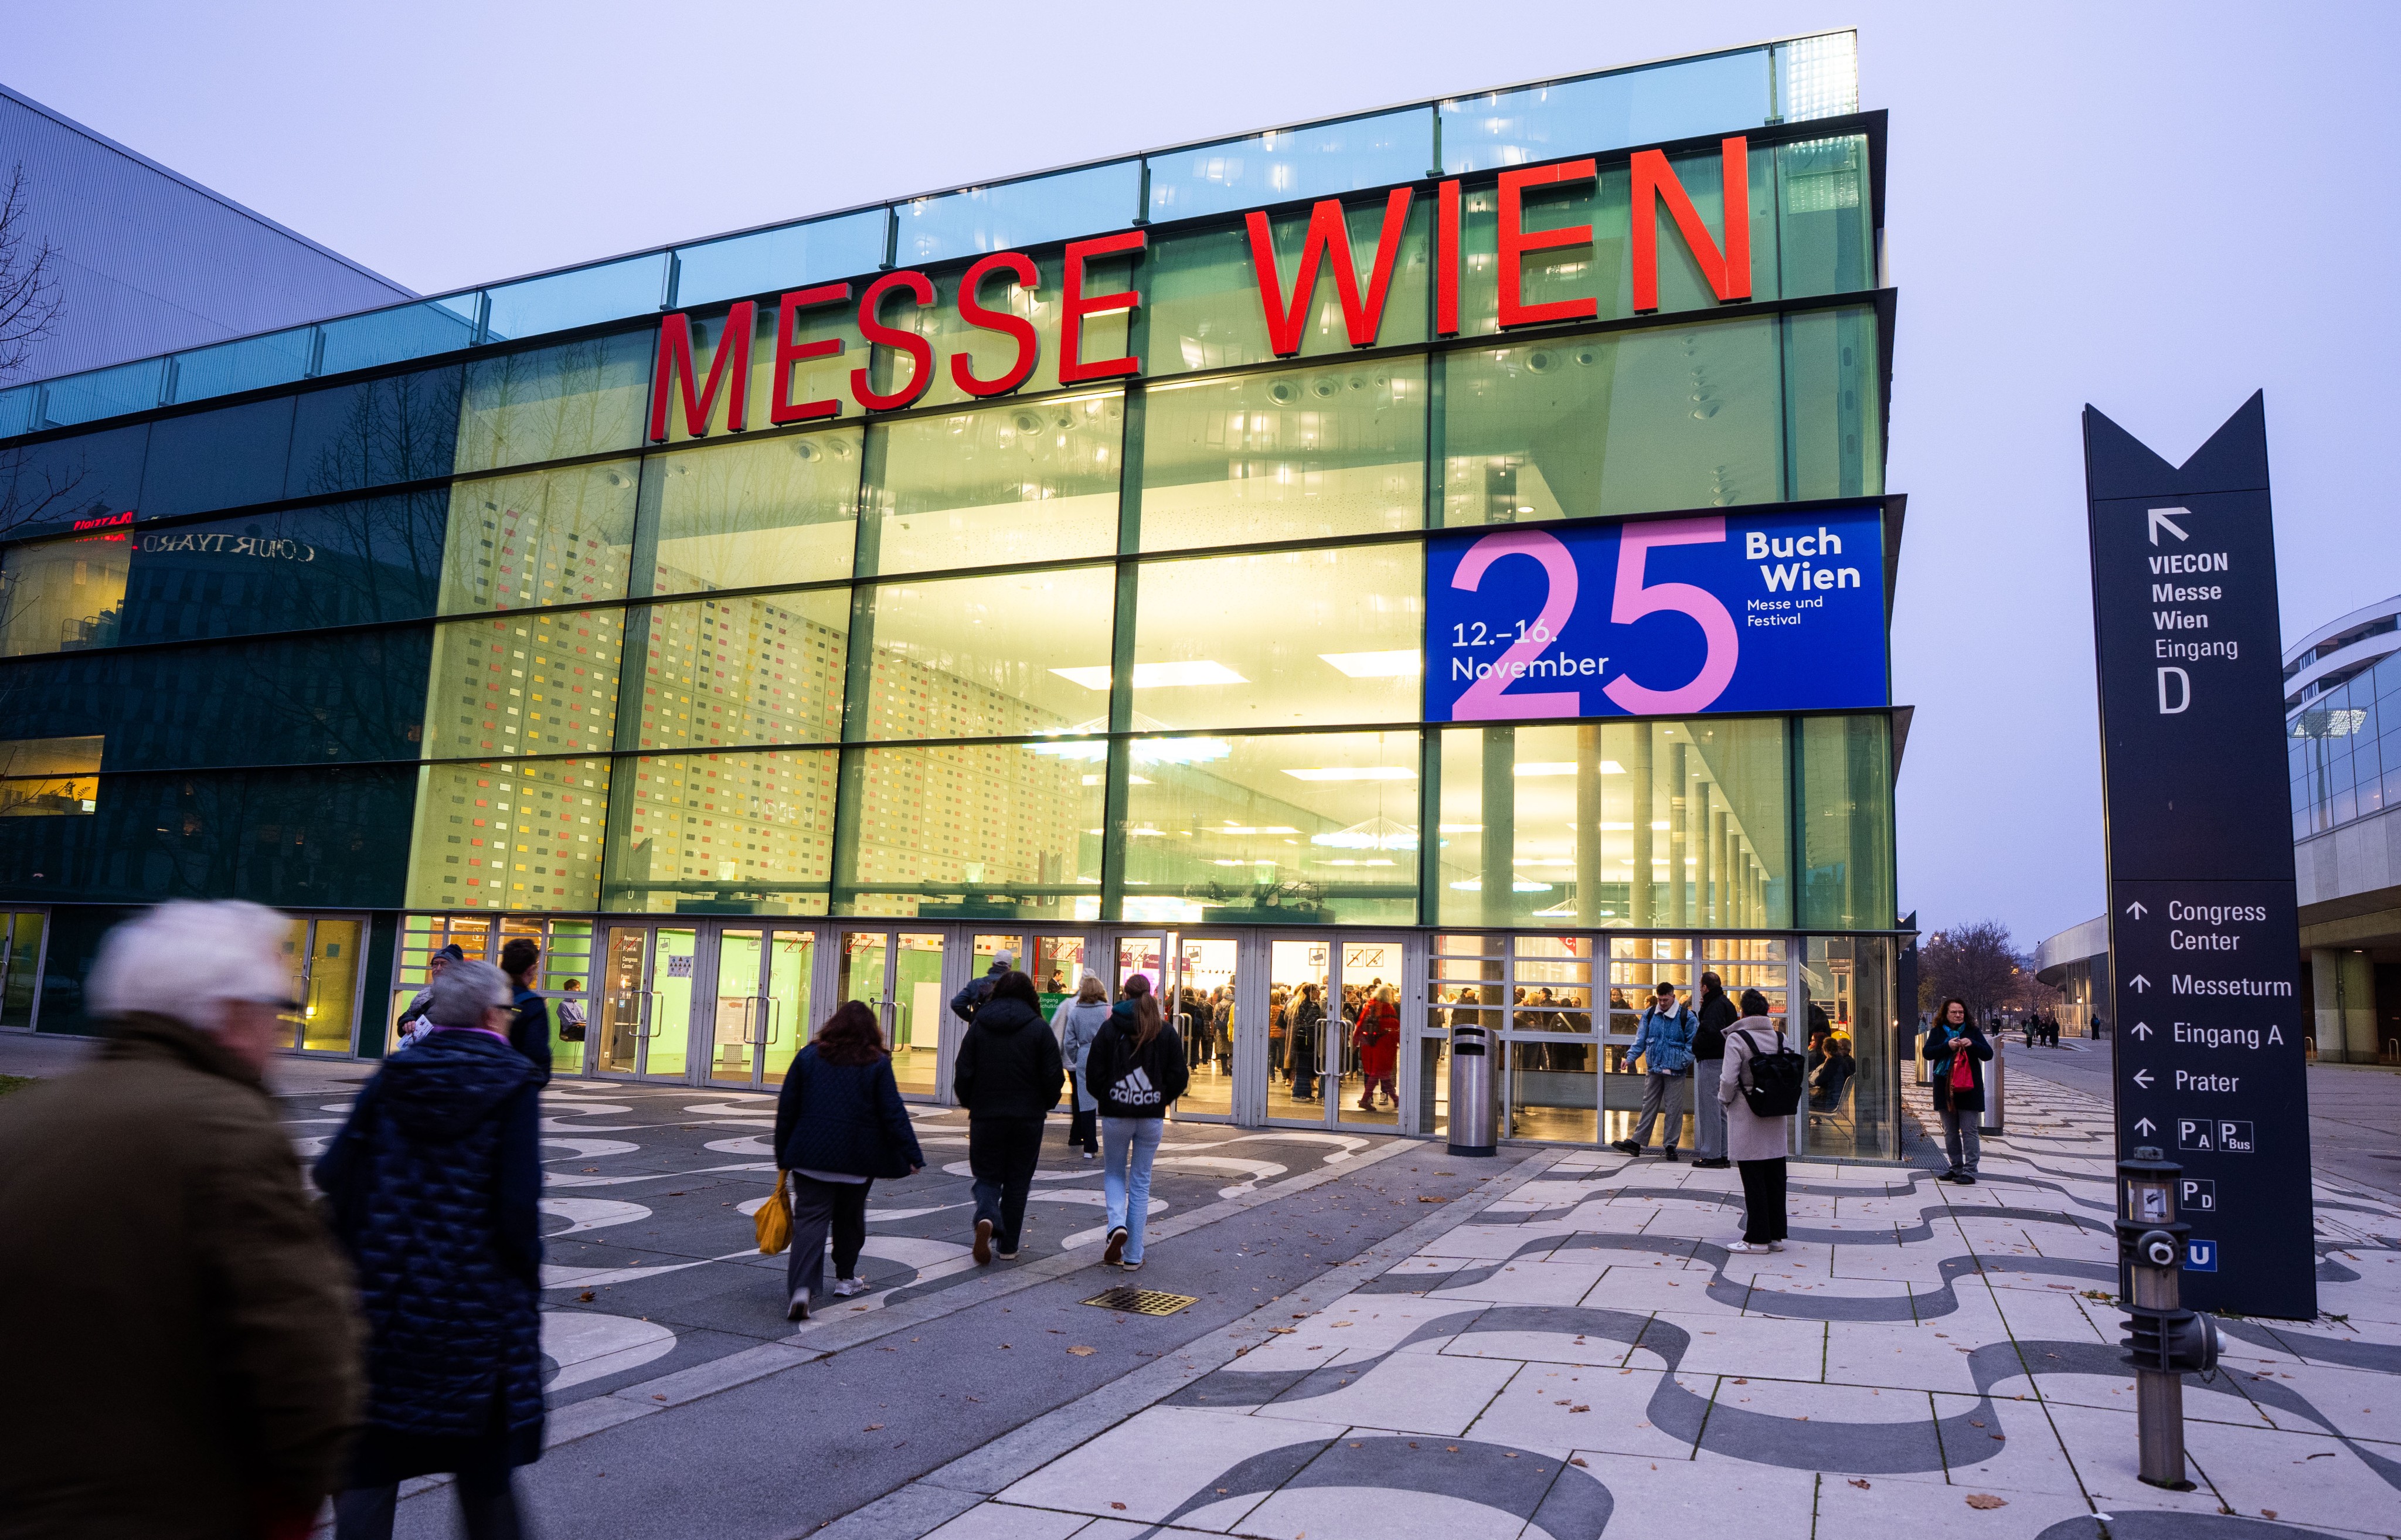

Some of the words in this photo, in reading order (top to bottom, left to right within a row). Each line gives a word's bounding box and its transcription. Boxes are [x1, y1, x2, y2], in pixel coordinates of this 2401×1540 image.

[650, 231, 1147, 443] MESSE
[1245, 135, 1752, 358] WIEN
[1746, 526, 1842, 560] Buch
[2148, 552, 2228, 574] VIECON
[1760, 561, 1861, 593] Wien
[1748, 598, 1791, 611] Messe
[1796, 595, 1823, 609] und
[2152, 583, 2222, 603] Messe
[1451, 516, 1739, 720] 25
[1747, 613, 1801, 627] Festival
[2152, 610, 2208, 630] Wien
[2155, 639, 2238, 661] Eingang
[1453, 651, 1609, 681] November
[2157, 667, 2191, 714] D
[2169, 900, 2266, 926] Congress
[2170, 929, 2240, 950] Center
[2172, 974, 2291, 997] Messeturm
[2174, 1022, 2259, 1049] Eingang
[2267, 1025, 2284, 1045] A
[2176, 1070, 2239, 1092] Prater
[1110, 1088, 1161, 1106] adidas
[2181, 1121, 2196, 1140] P
[2198, 1135, 2210, 1148] A
[2222, 1123, 2236, 1142] P
[2229, 1137, 2250, 1150] Bus
[2184, 1182, 2198, 1201] P
[2202, 1195, 2212, 1208] D
[2191, 1246, 2209, 1264] U
